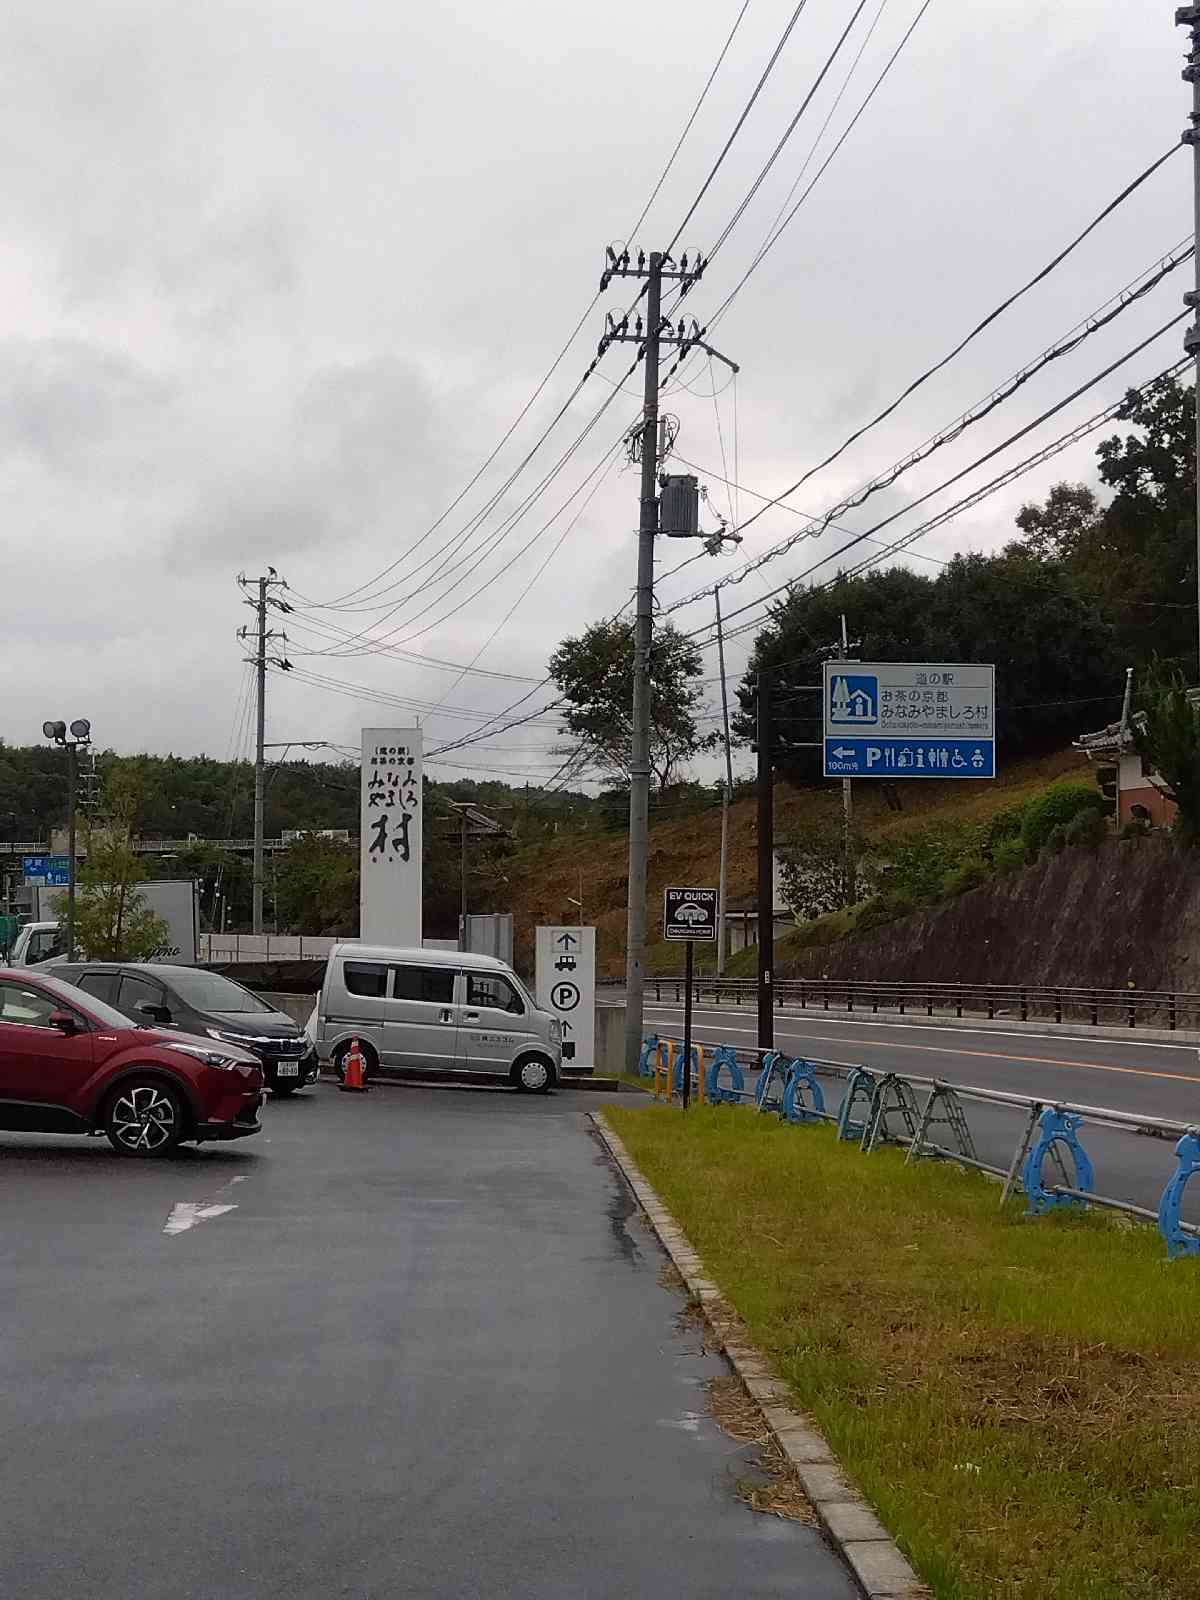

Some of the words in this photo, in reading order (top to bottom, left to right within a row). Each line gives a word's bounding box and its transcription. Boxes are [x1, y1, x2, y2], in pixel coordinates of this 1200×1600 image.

[881, 690, 949, 703] お茶の京都
[881, 705, 988, 720] みなみやましろ村
[368, 812, 413, 863] 村
[669, 891, 682, 900] EV
[684, 891, 714, 901] QUICK
[559, 987, 573, 1005] P
